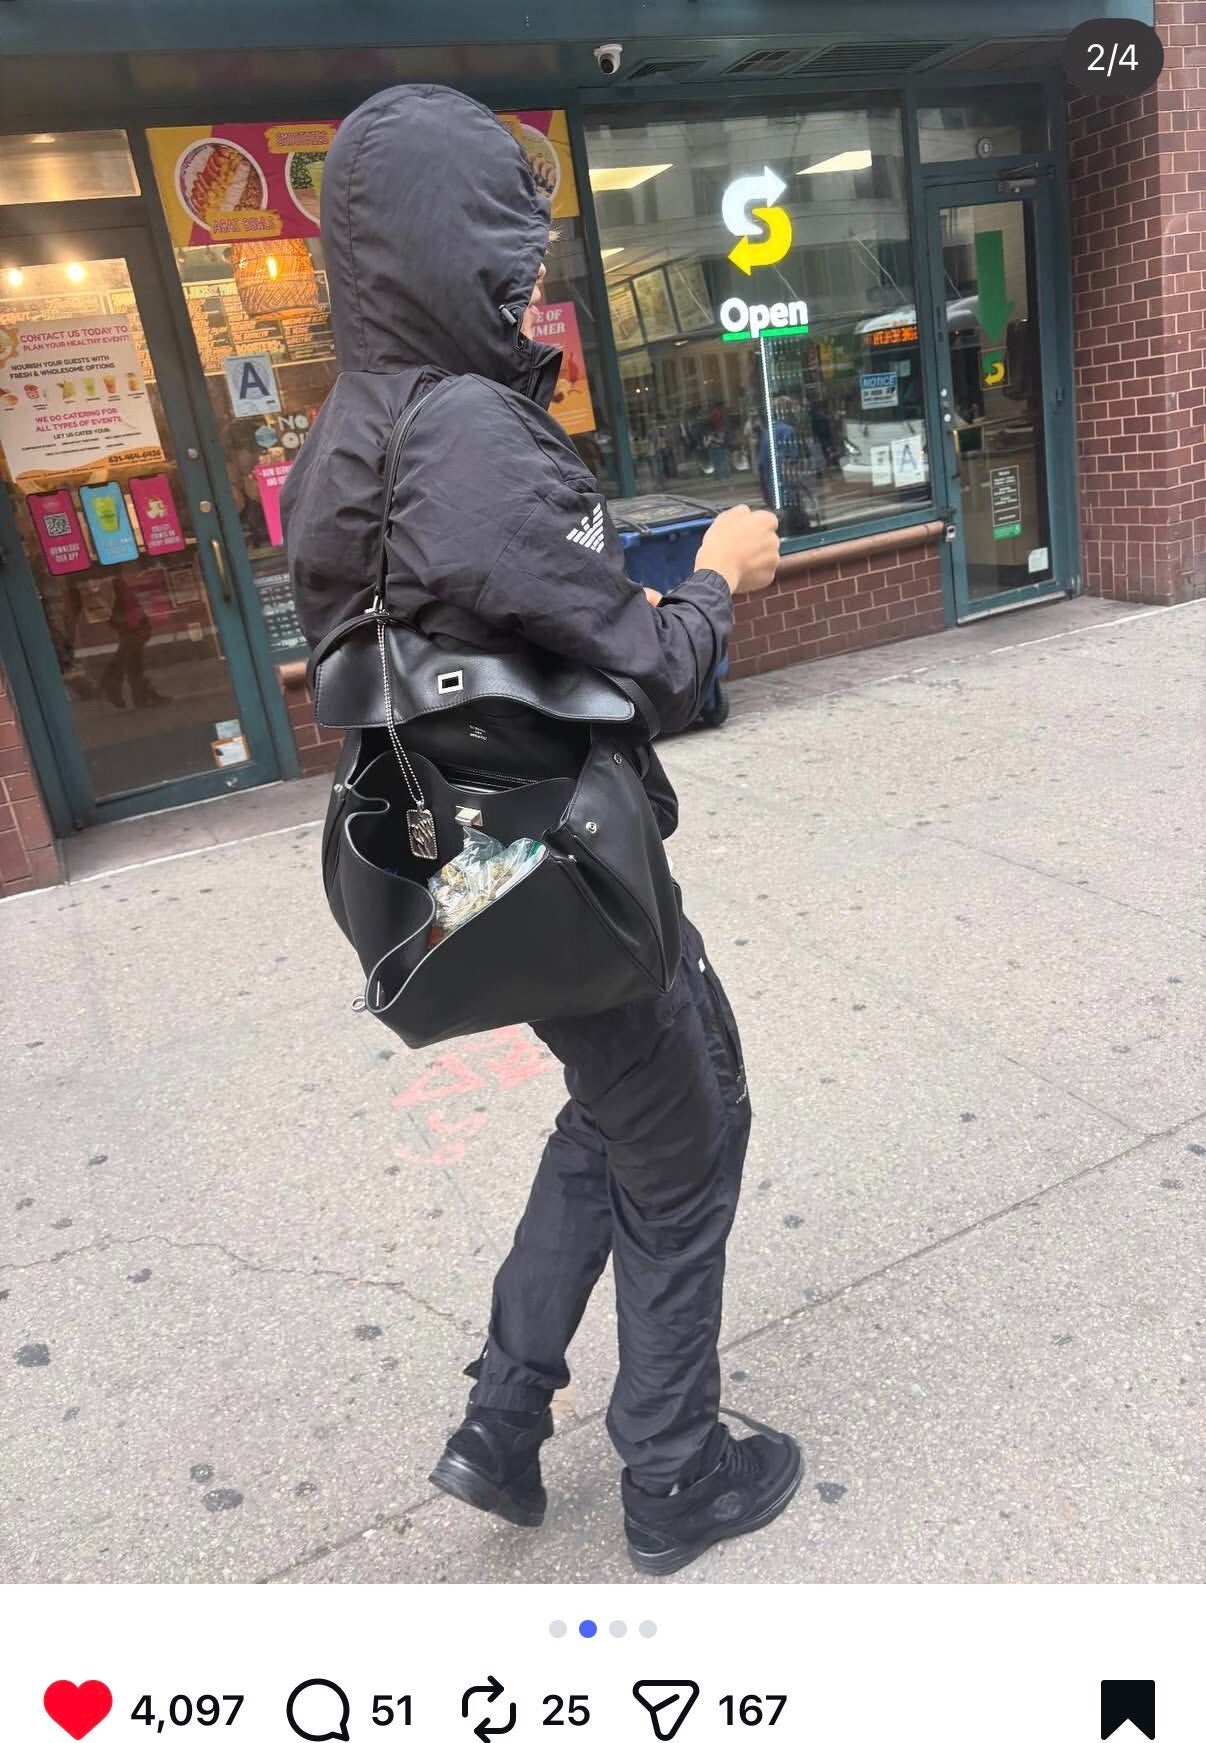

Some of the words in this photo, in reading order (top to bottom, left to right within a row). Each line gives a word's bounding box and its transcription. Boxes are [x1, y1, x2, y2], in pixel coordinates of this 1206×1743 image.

[720, 297, 809, 338] Open
[20, 331, 65, 344] CONTACT
[68, 329, 80, 338] US
[83, 326, 112, 337] TODAY
[114, 325, 128, 333] TO
[23, 343, 44, 352] PLAN
[45, 341, 66, 350] YOUR
[66, 338, 101, 348] HEALTHY
[10, 370, 33, 379] FRESH
[33, 369, 39, 377] &
[41, 365, 85, 376] WHOLESOME
[86, 362, 115, 371] OPTIONS
[11, 362, 43, 371] NOURISH
[43, 360, 63, 368] YOUR
[64, 356, 91, 366] GUESTS
[240, 361, 271, 400] A
[863, 375, 897, 387] NOTICE
[35, 415, 49, 423] WE
[50, 413, 63, 422] DO
[63, 409, 101, 421] CATERING
[101, 407, 118, 416] FOR
[35, 424, 52, 433] ALL
[52, 420, 78, 431] TYPES
[79, 419, 89, 427] OF
[91, 416, 122, 426] EVENTS
[74, 429, 93, 437] CATER
[900, 443, 918, 473] A
